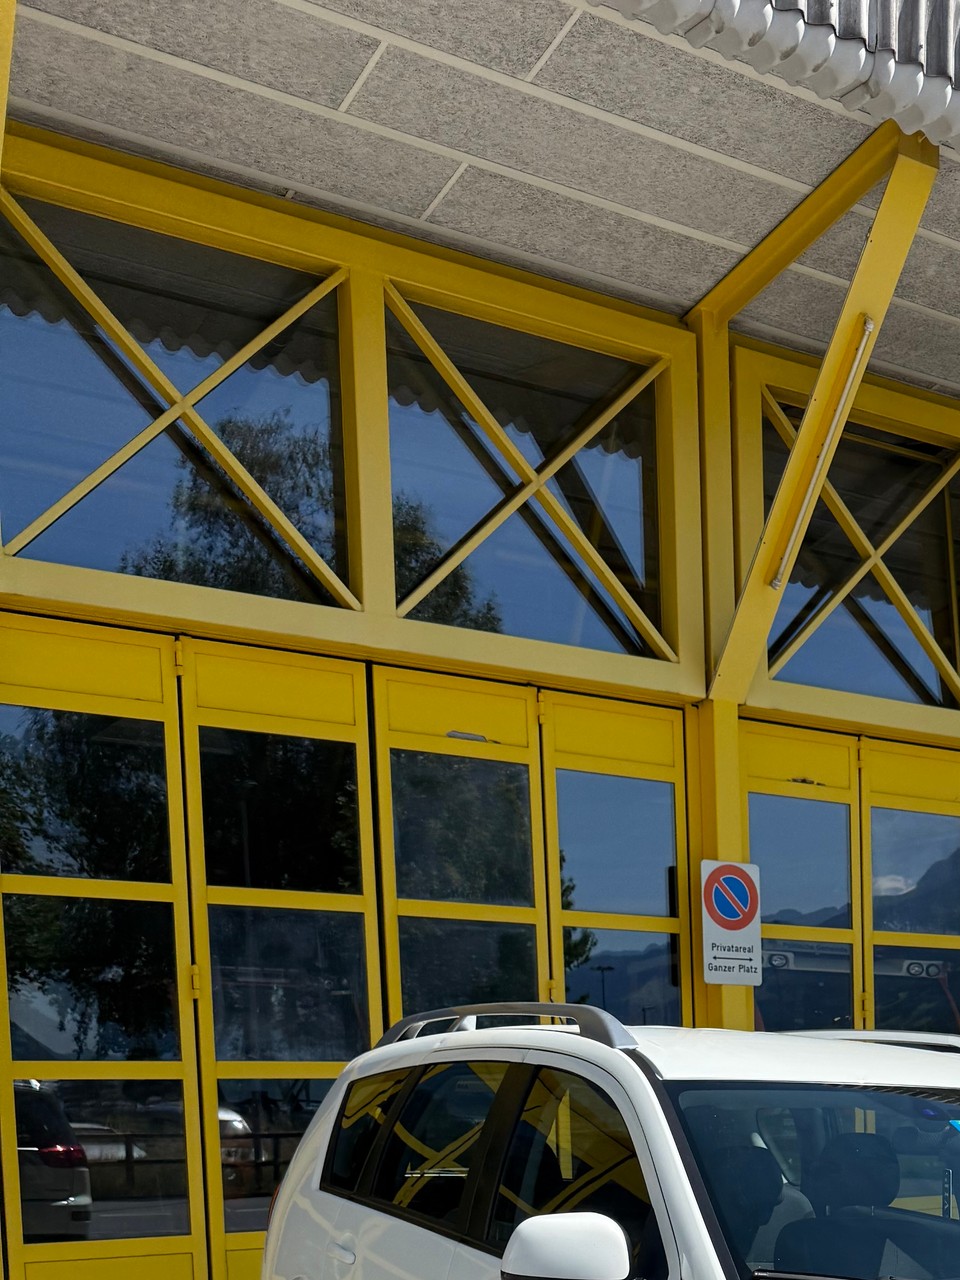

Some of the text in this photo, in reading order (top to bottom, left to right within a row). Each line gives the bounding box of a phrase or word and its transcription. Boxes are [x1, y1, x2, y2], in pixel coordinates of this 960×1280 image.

[711, 942, 754, 954] Privatareal
[708, 963, 758, 974] Ganzer Platz
